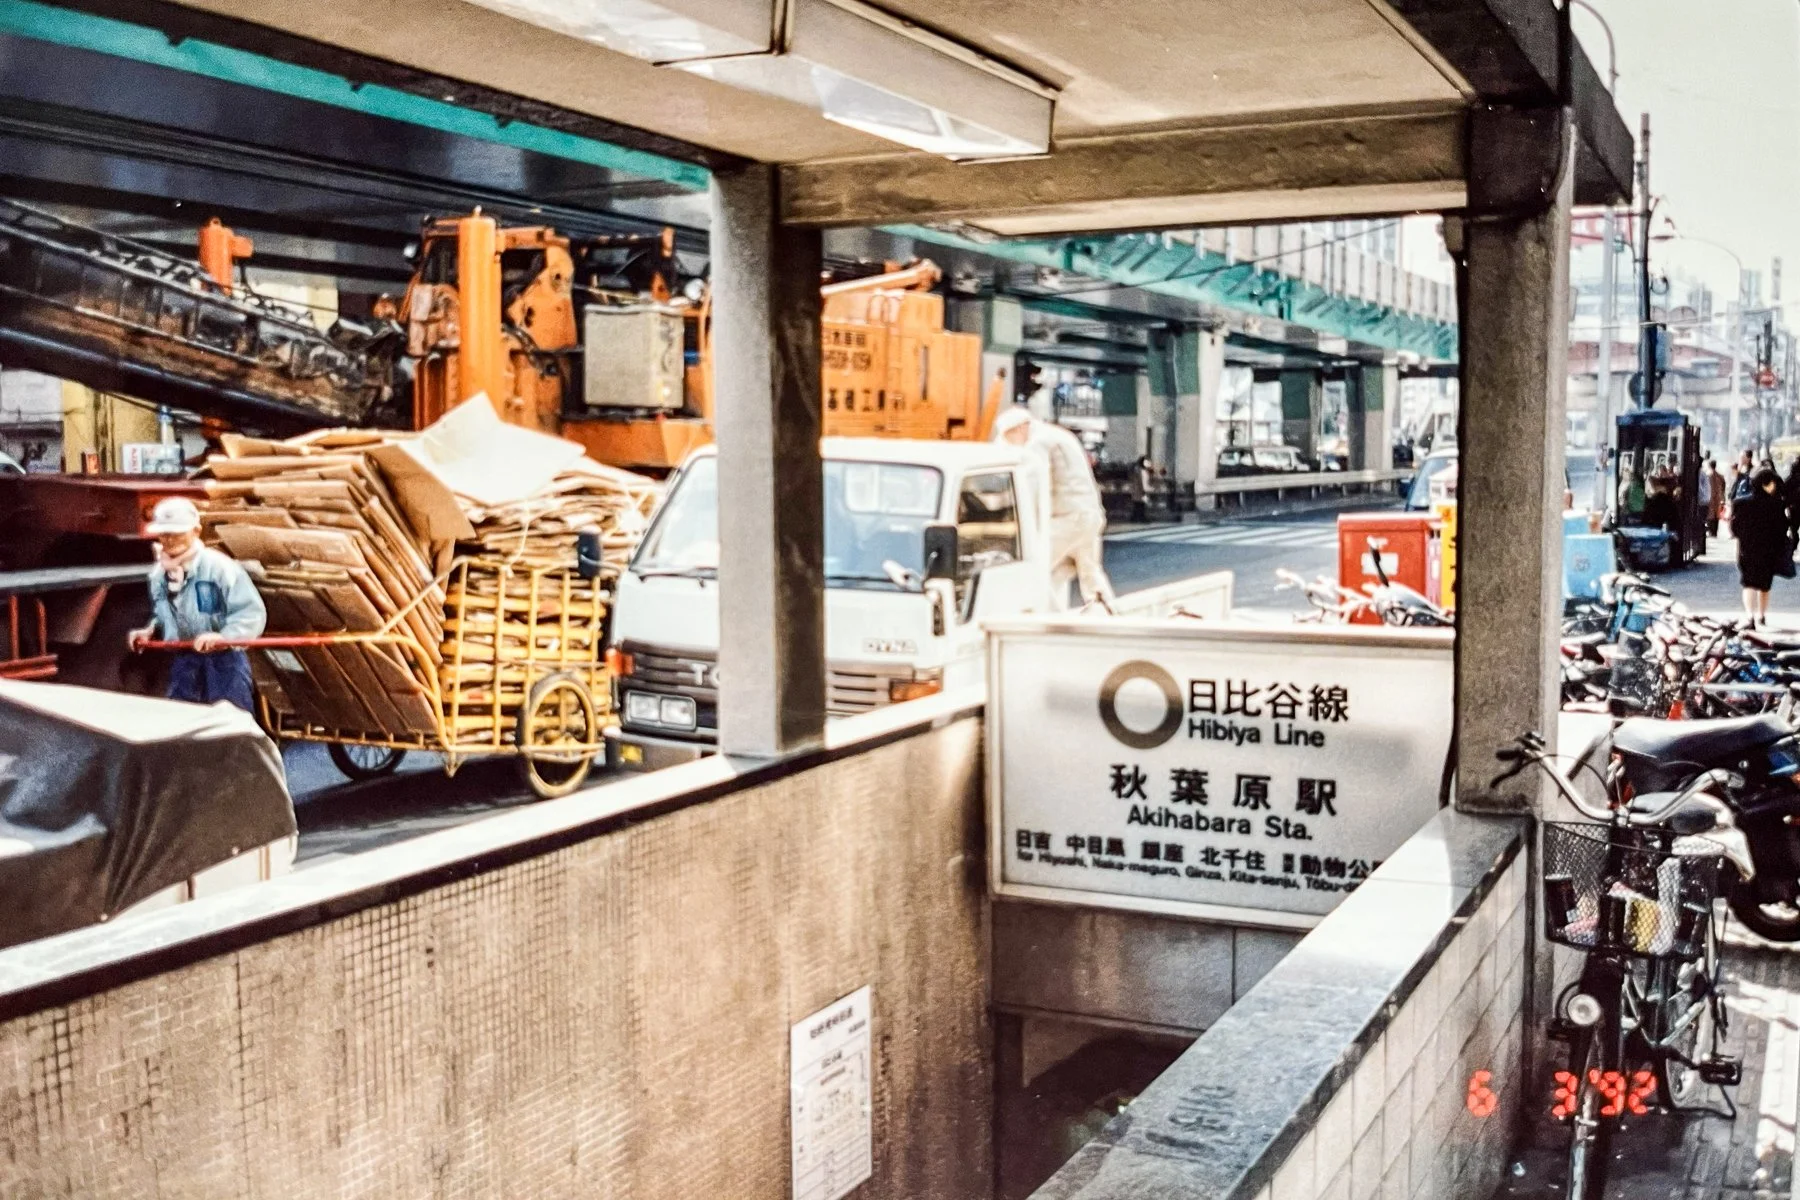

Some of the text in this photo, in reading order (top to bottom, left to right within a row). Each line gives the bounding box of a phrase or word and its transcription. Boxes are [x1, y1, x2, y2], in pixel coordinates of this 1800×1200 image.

[1189, 679, 1349, 723] 日比谷線
[1188, 718, 1325, 748] Hibiya Line
[1109, 763, 1337, 817] 秋葉原駅
[1127, 804, 1313, 840] Akihabara Sta.
[1066, 834, 1125, 857] 中目黒
[1199, 846, 1266, 872] 北千住
[1092, 857, 1181, 876] Naka-meguro,
[1185, 866, 1225, 882] Ginza,
[1229, 871, 1300, 889] Kita-senju,
